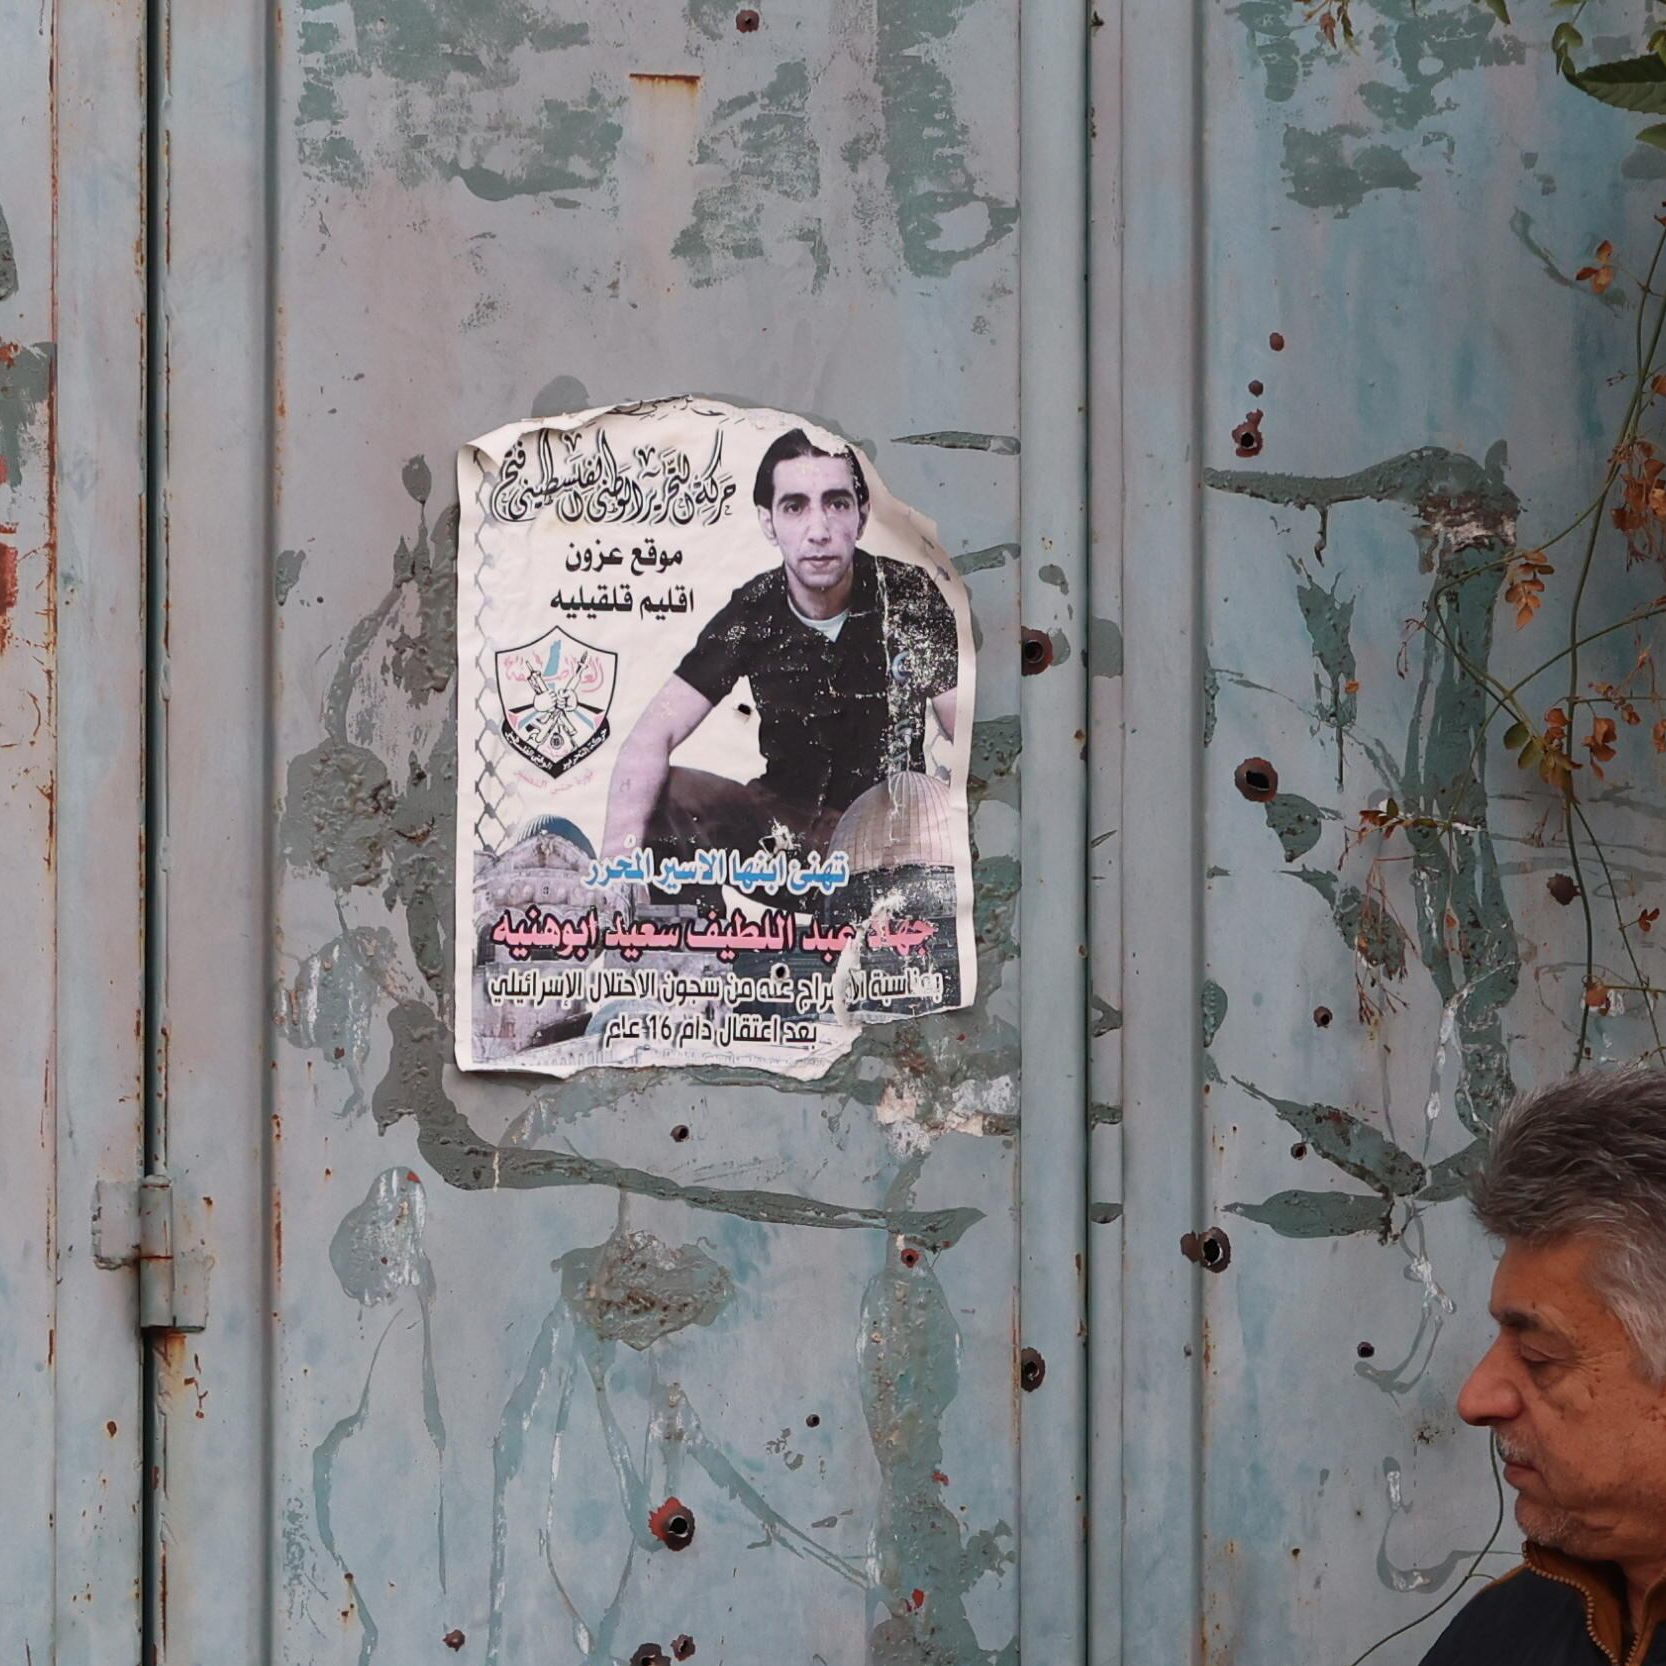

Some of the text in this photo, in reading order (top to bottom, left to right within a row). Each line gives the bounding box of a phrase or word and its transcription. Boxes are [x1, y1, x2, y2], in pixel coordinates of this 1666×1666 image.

[565, 539, 683, 576] موقع عزون
[550, 584, 694, 620] اقليم قلقيليه
[657, 851, 725, 890] الاسير
[731, 852, 785, 892] ابنها
[604, 911, 681, 961] سعيد
[685, 909, 795, 962] اللطيف
[801, 920, 856, 963] عبد
[490, 971, 581, 1008] الإسرائيلي
[589, 971, 654, 1002] الاحتلال
[661, 972, 720, 1006] سجون
[725, 974, 753, 1004] من
[605, 1015, 818, 1050] بعد اعتقال دام 16 عام
